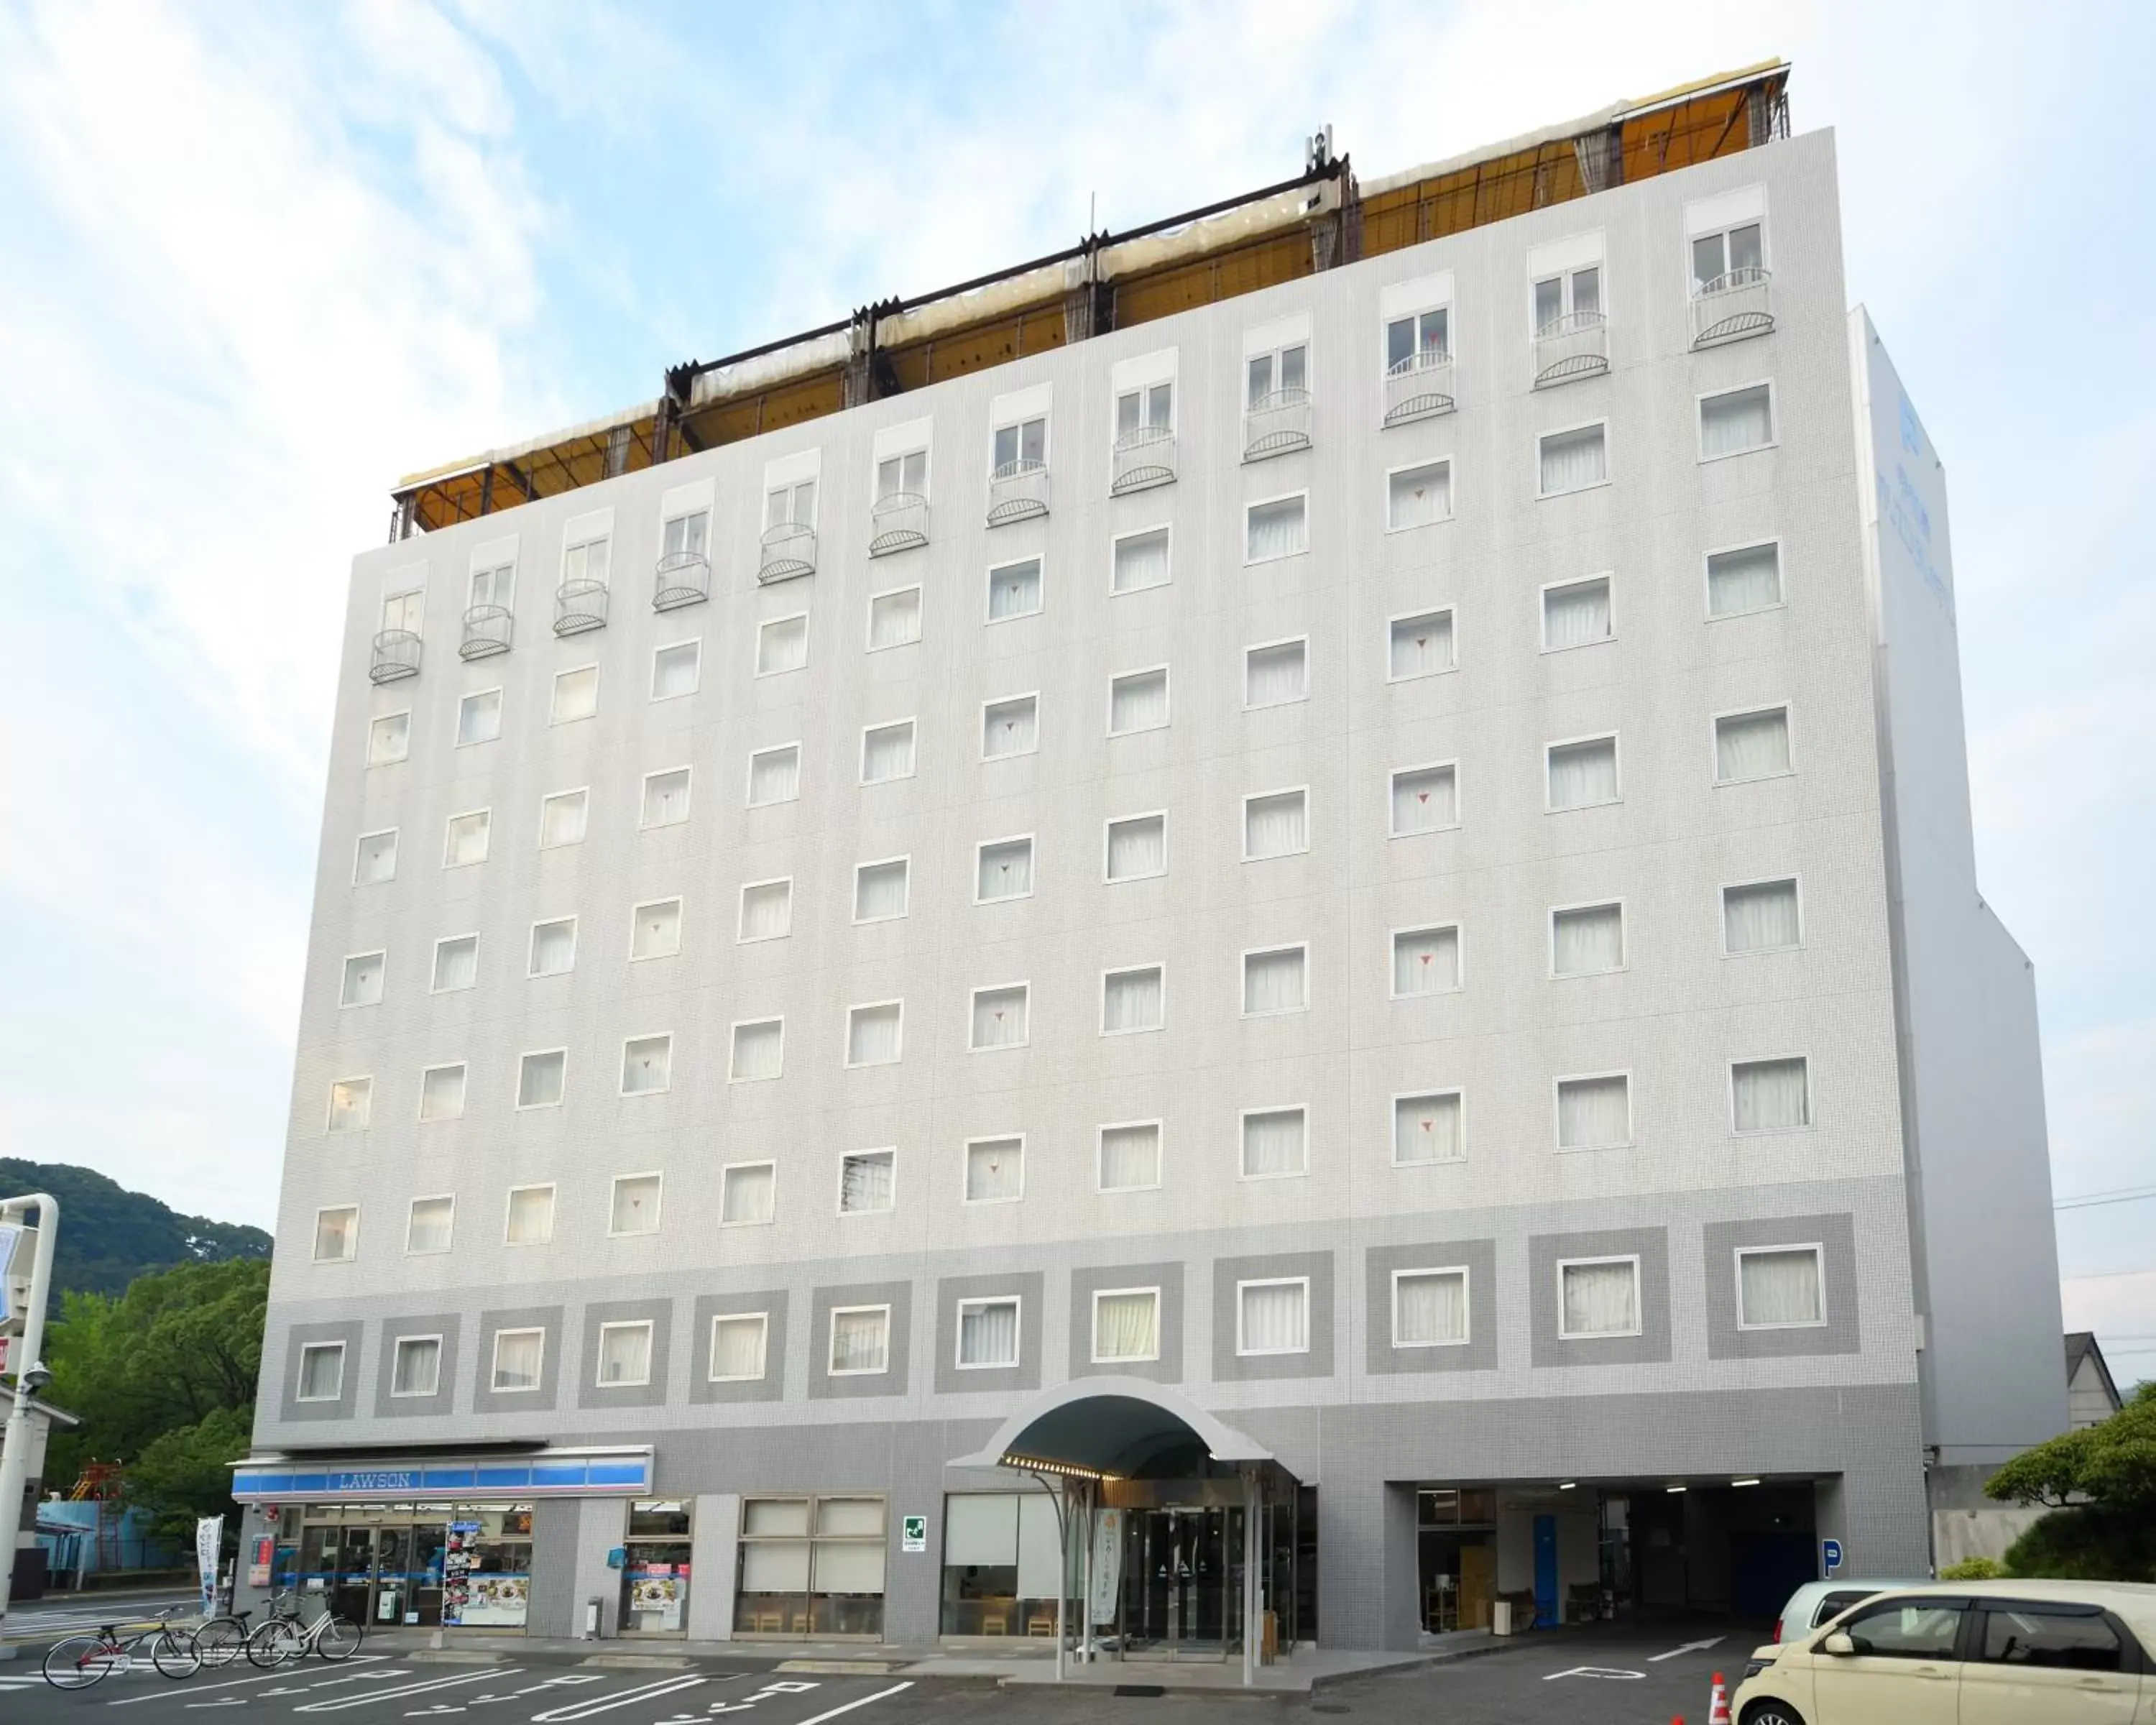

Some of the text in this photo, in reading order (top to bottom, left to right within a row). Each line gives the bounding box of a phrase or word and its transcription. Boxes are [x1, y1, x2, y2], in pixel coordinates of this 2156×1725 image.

[339, 1473, 410, 1489] LAWSON
[1823, 1539, 1843, 1579] P
[1542, 1666, 1646, 1680] P
